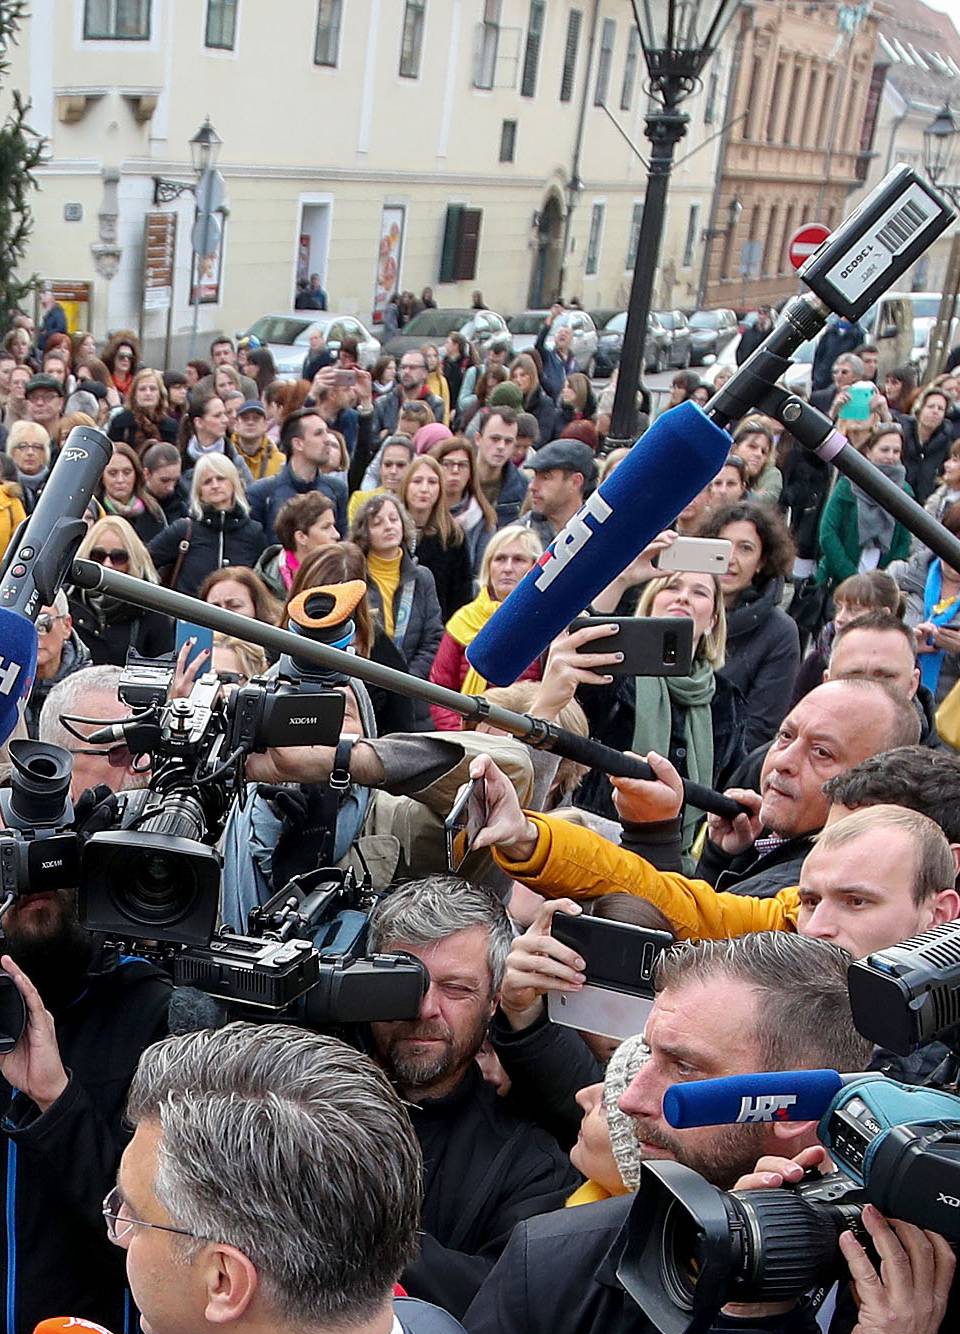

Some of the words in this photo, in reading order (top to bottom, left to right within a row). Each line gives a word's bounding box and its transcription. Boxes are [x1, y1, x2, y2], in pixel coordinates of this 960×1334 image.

[840, 244, 874, 279] 136030
[289, 717, 318, 725] XDCAM
[41, 859, 63, 869] XDCAM
[735, 1094, 797, 1122] HRT
